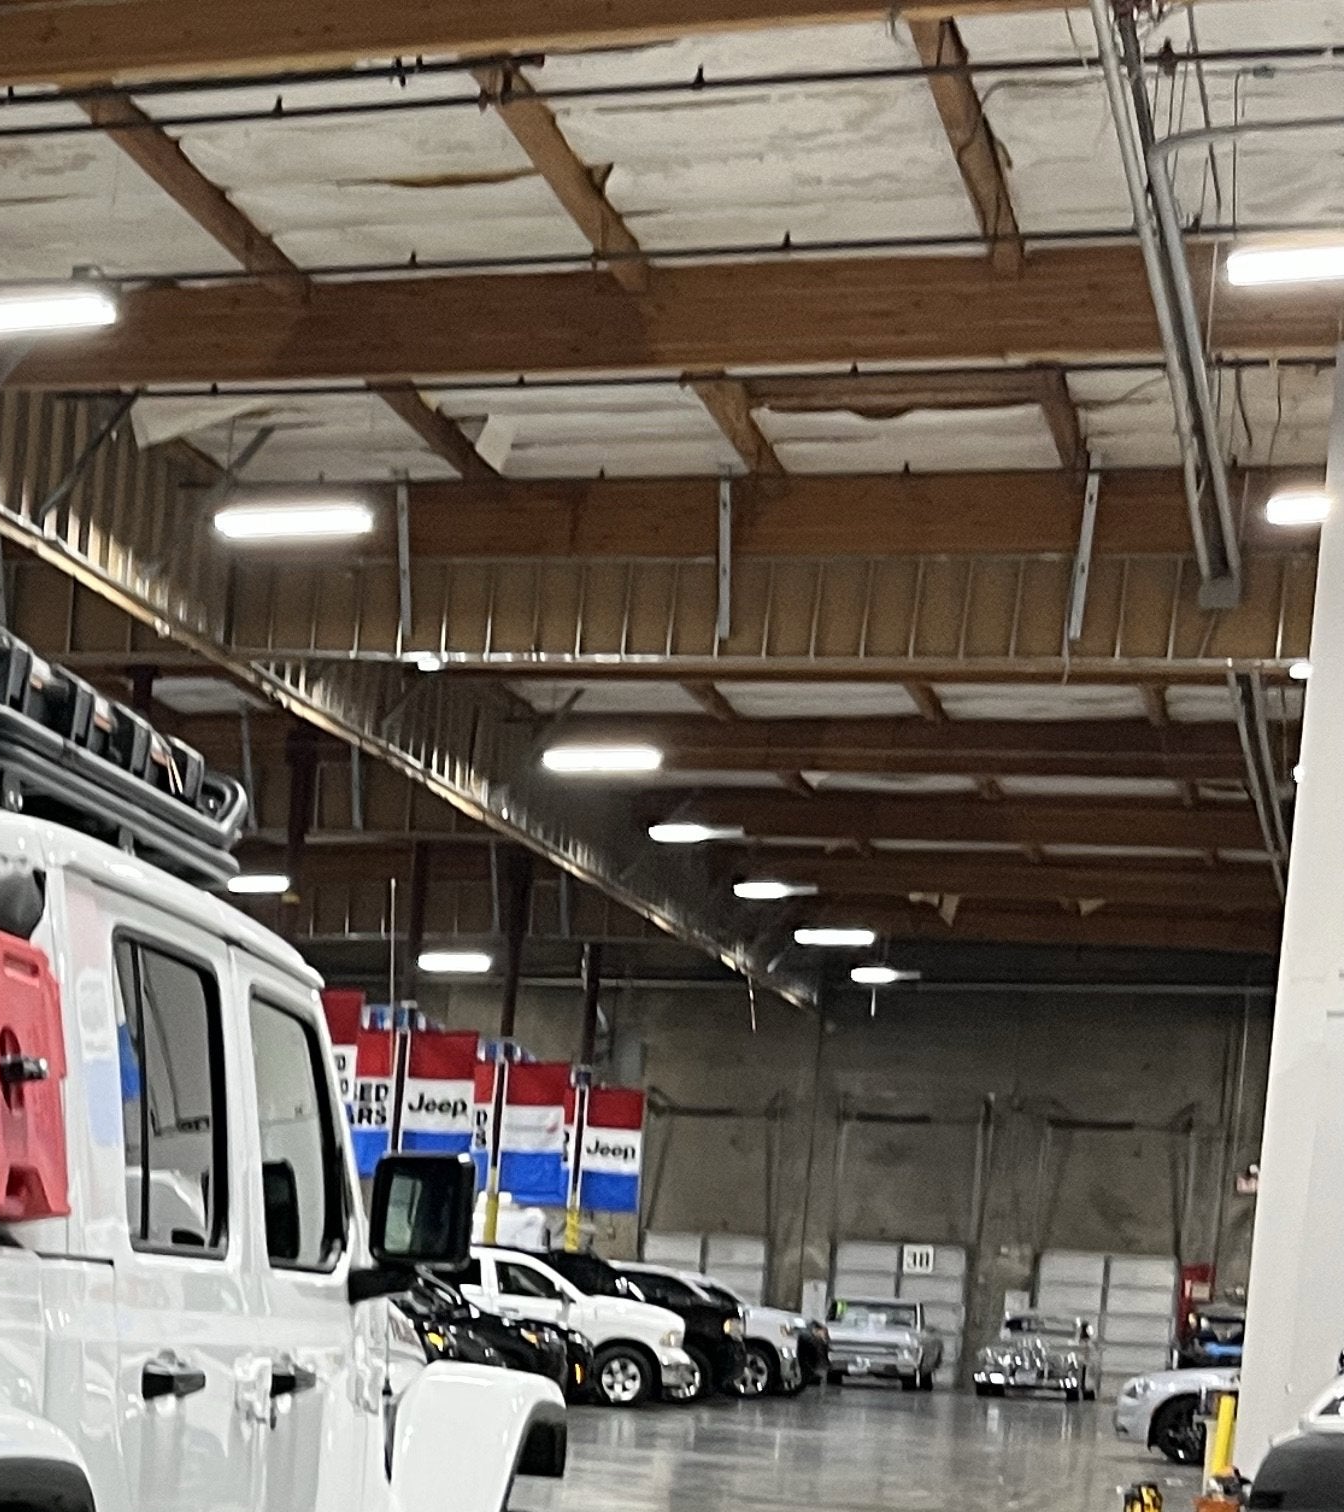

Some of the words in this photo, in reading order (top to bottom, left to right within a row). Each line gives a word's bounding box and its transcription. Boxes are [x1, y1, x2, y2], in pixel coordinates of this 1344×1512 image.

[354, 1083, 388, 1102] ED
[408, 1092, 468, 1118] Jeep
[586, 1139, 636, 1160] Jeep
